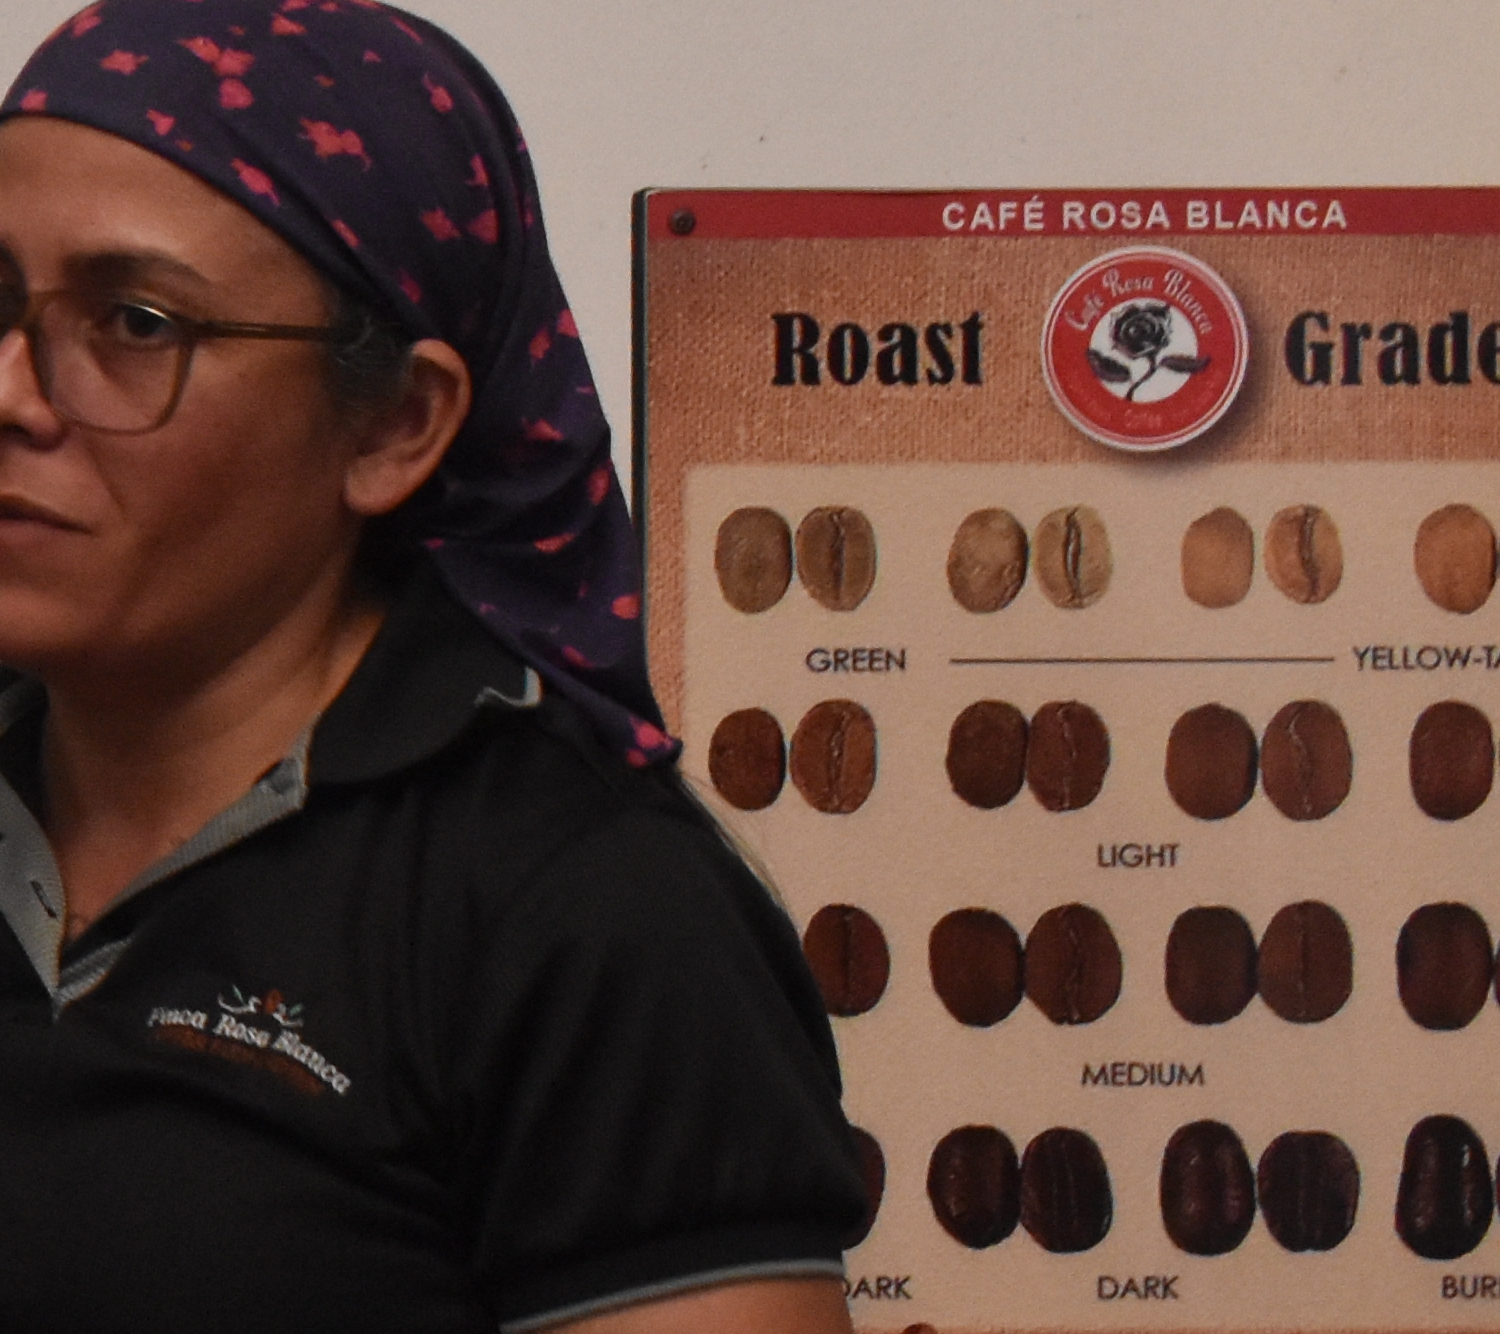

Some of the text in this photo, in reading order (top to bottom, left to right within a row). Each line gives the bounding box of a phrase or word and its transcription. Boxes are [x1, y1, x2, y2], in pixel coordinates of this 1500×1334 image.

[942, 195, 1348, 231] CAFÉ ROSA BLANCA
[771, 311, 984, 386] Roast
[805, 647, 907, 673] GREEN
[1097, 843, 1180, 868] LIGHT
[1082, 1062, 1205, 1086] MEDIUM
[1097, 1274, 1179, 1300] DARK
[1442, 1274, 1500, 1299] BUR
